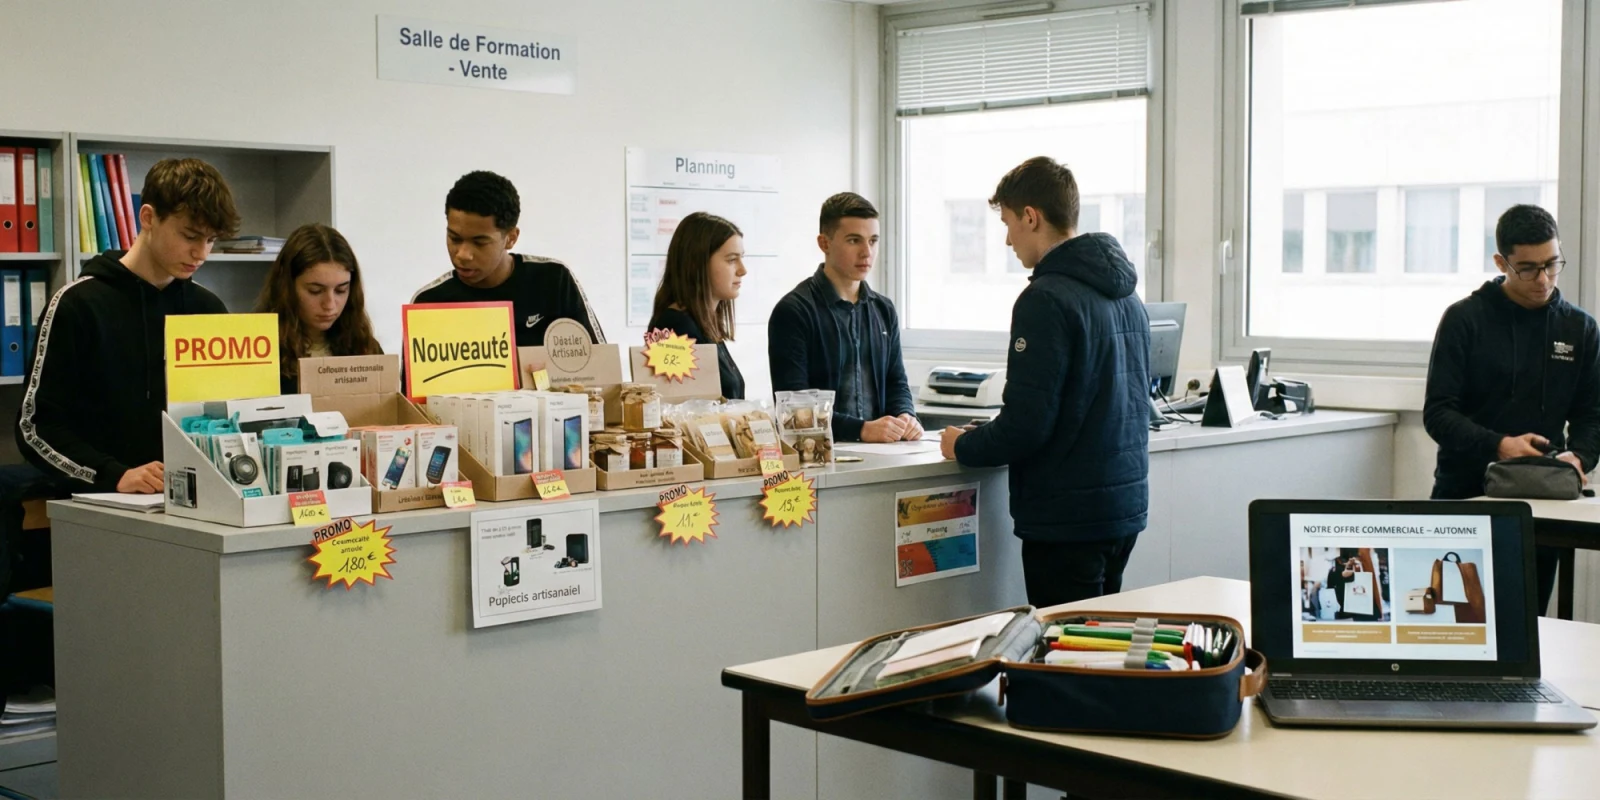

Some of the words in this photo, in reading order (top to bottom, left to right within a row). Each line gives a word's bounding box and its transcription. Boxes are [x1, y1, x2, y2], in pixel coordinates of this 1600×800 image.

[399, 27, 443, 48] Salle
[449, 33, 470, 51] de
[476, 36, 561, 61] Formation
[459, 59, 508, 80] Vente
[675, 157, 736, 179] Planning
[174, 335, 272, 361] PROMO
[412, 332, 509, 363] Nouveauté
[552, 345, 588, 358] Artisanal
[659, 484, 687, 503] PROMO
[313, 518, 352, 542] PROMO
[1303, 525, 1332, 534] NOTRE
[1333, 525, 1360, 534] OFFRE
[1361, 526, 1424, 535] COMMERCIALE
[1433, 526, 1478, 535] AUTOMNE
